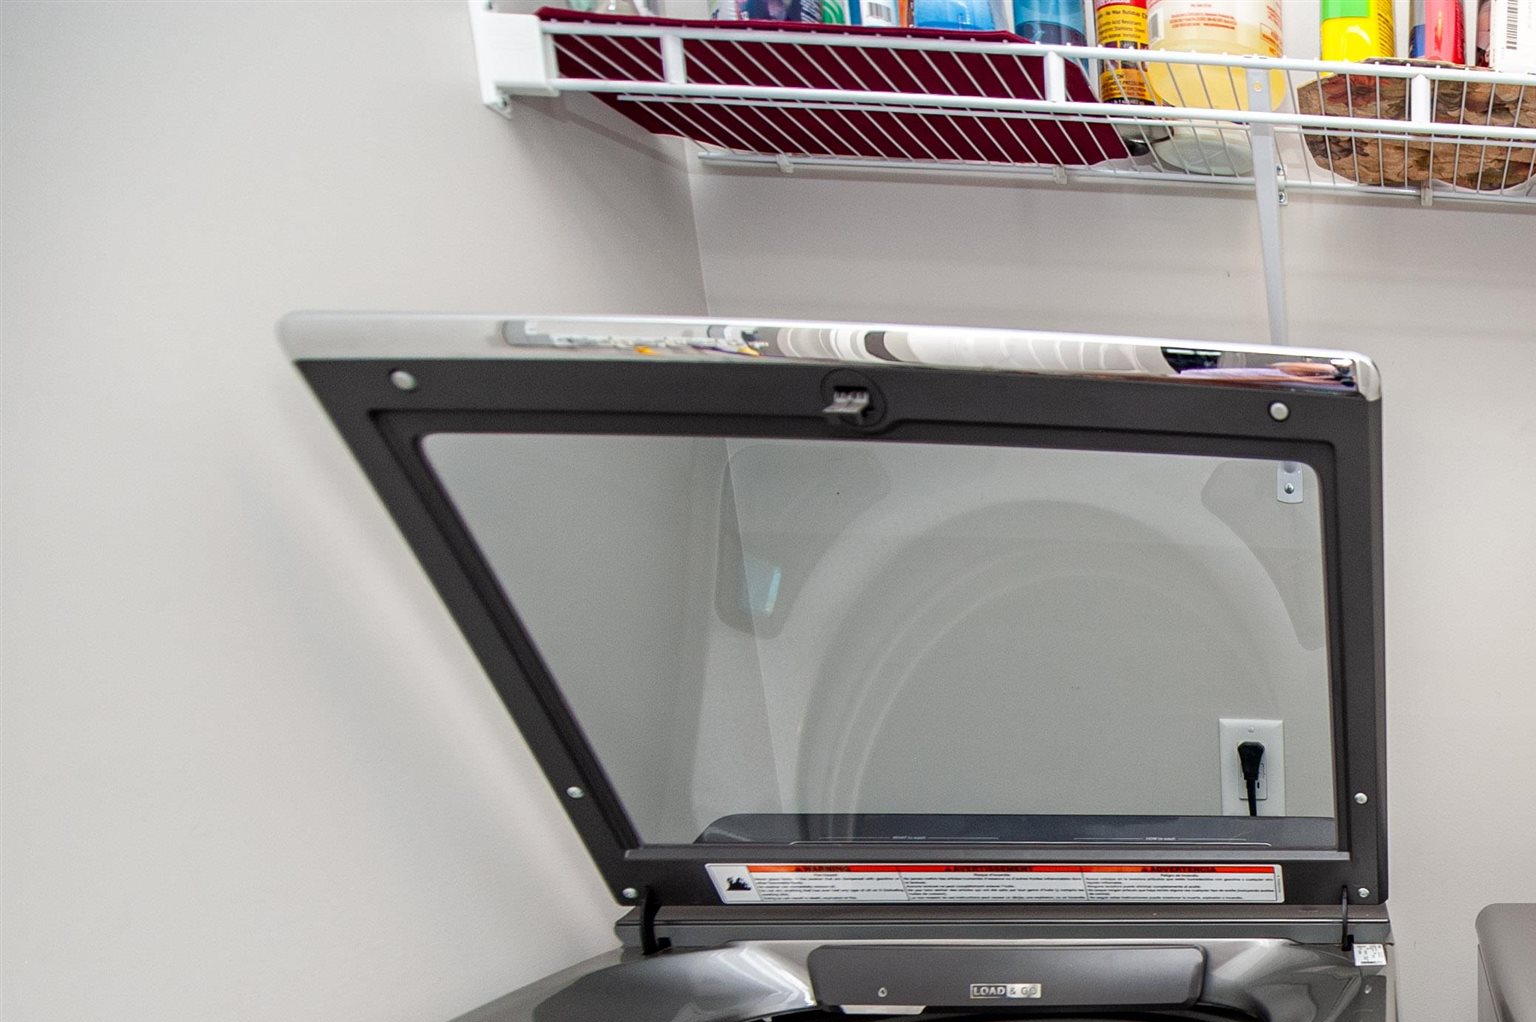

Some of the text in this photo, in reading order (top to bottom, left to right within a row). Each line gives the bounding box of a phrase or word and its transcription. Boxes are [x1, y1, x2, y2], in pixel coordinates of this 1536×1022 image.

[973, 986, 1038, 996] LOAD & GO
